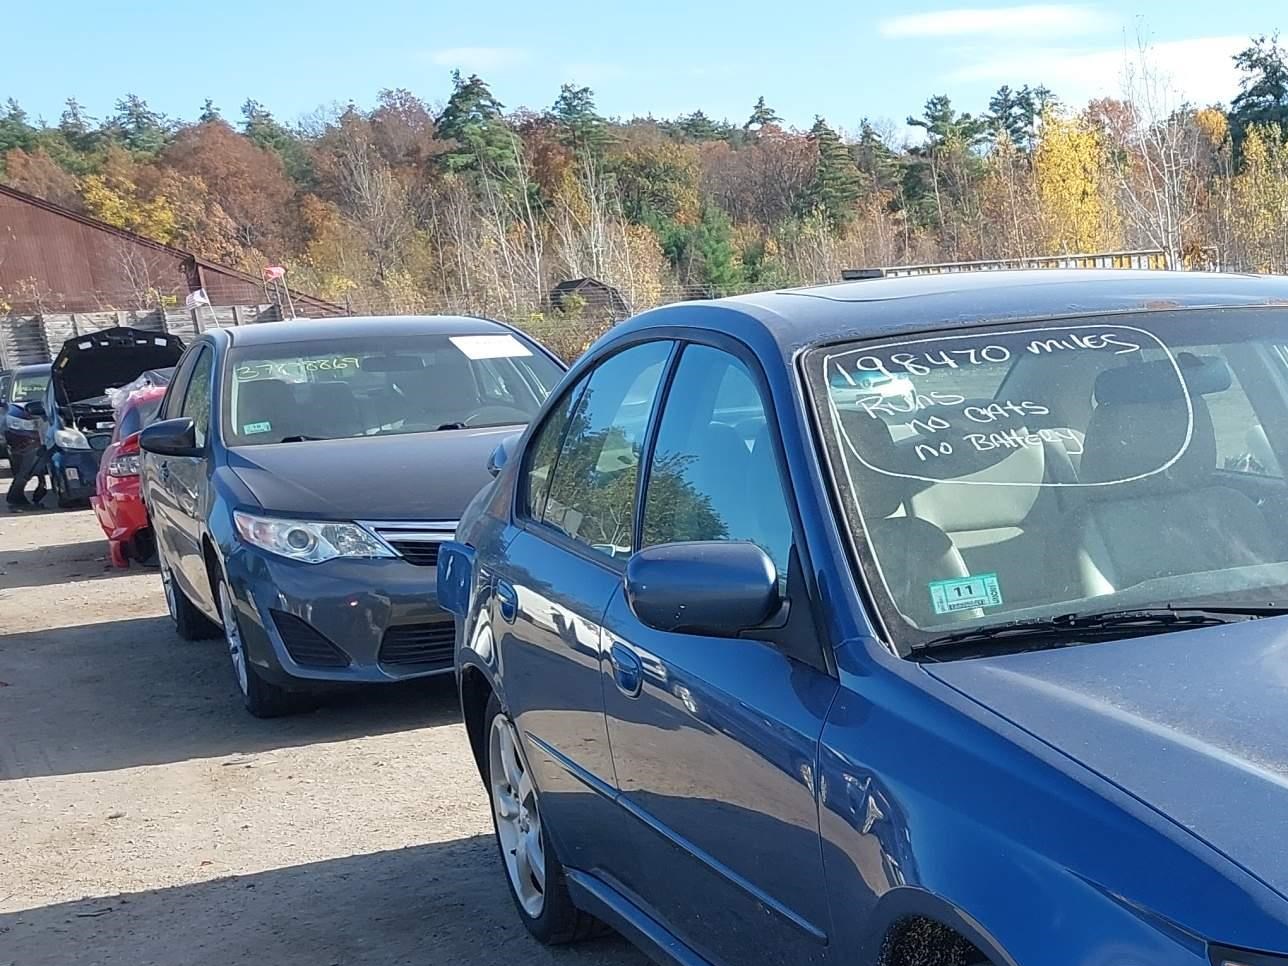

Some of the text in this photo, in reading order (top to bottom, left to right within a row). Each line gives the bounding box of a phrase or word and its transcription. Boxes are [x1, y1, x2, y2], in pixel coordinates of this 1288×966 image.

[836, 345, 1011, 387] 198470
[905, 415, 951, 434] no
[914, 441, 953, 461] no
[953, 584, 973, 597] 11
